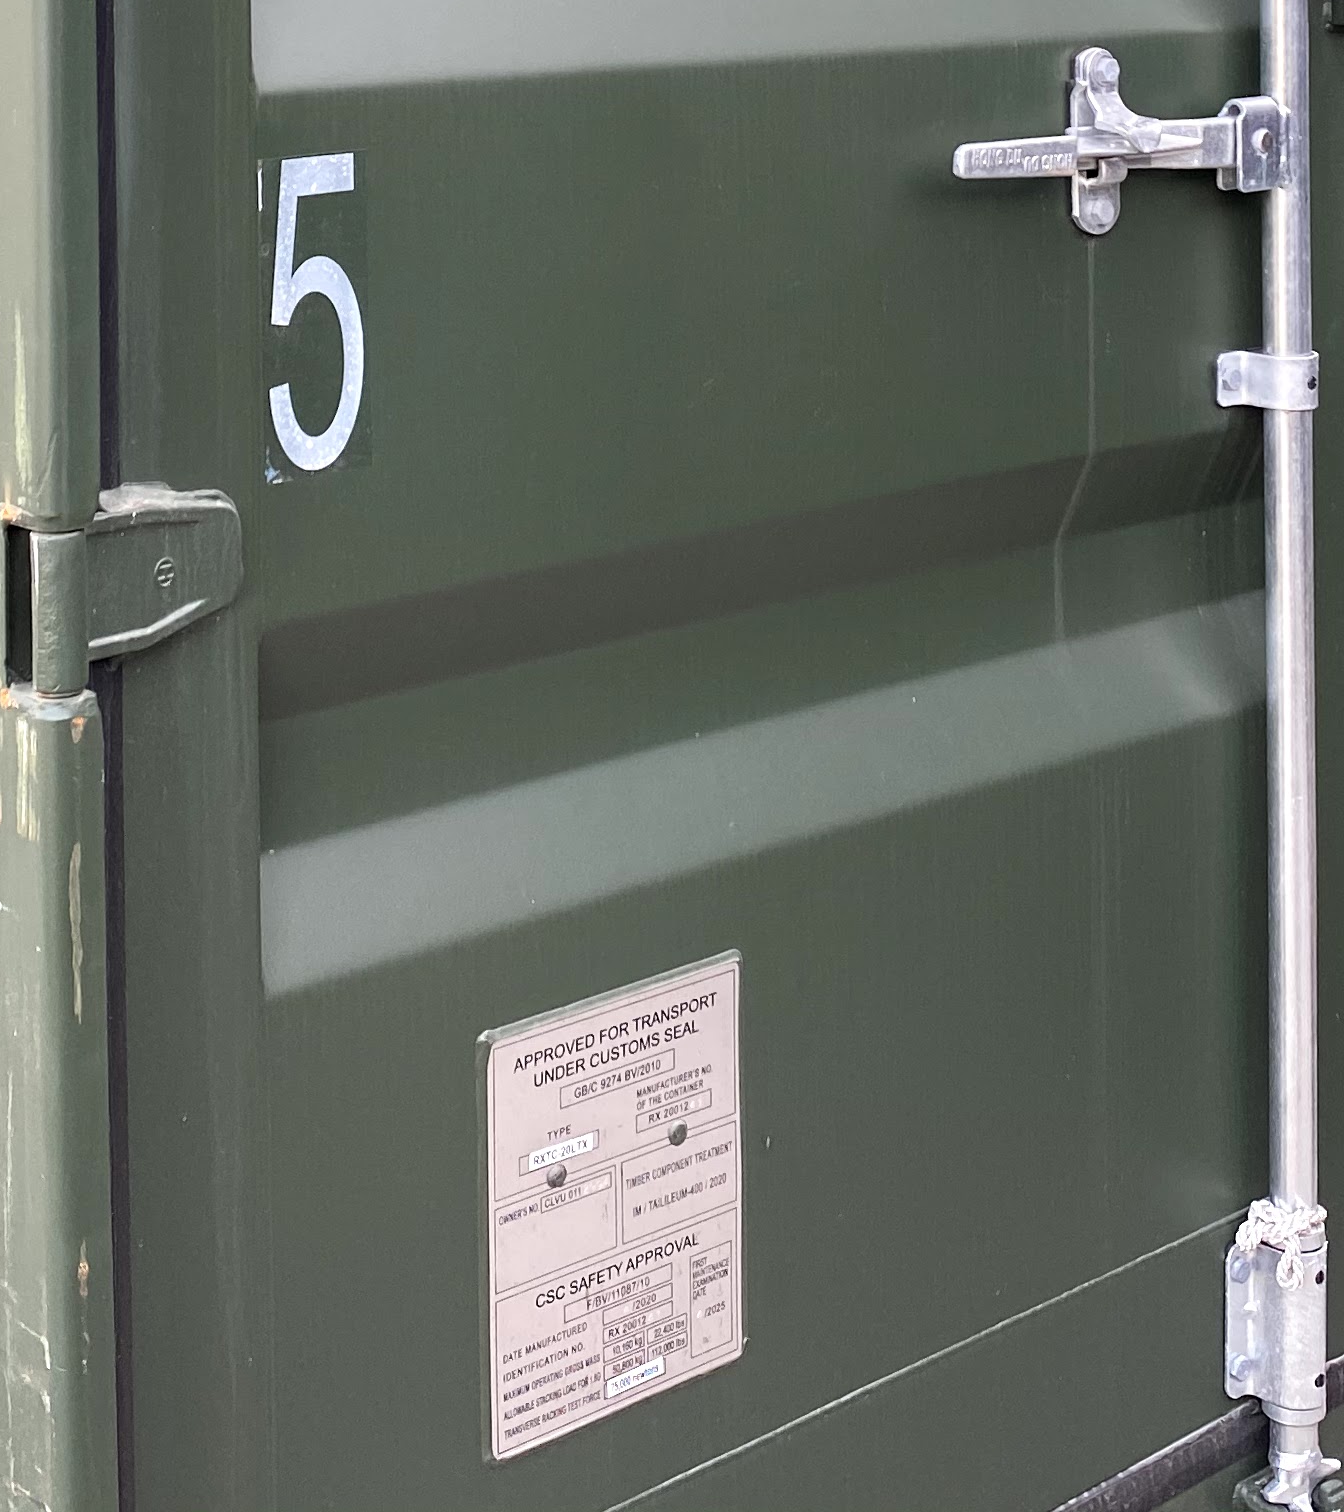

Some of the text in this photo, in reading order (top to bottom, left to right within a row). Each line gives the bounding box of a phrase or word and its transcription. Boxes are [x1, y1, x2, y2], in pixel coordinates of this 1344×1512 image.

[269, 152, 365, 471] 5
[513, 993, 717, 1073] APPROVED FOR TRANSPORT
[534, 1020, 699, 1088] UNDER CUSTOMS SEAL
[573, 1060, 661, 1099] GB/C 9274 BV/2010
[636, 1070, 699, 1098] MANUFACTURER'S
[636, 1080, 704, 1110] OF THE CONTAINER
[546, 1126, 571, 1141] TYPE
[648, 1112, 661, 1124] RX
[625, 1142, 732, 1189] TIMBER COMPONENT TREATMENT
[498, 1208, 528, 1225] OWNER'S
[544, 1194, 566, 1208] CLVU
[535, 1233, 699, 1309] CSC SAFETY APPROVAL
[502, 1348, 523, 1364] DATE
[524, 1322, 587, 1355] MANUFACTURED
[502, 1350, 568, 1383] IDENTIFICATION
[571, 1341, 585, 1353] NO.
[607, 1329, 619, 1340] RX
